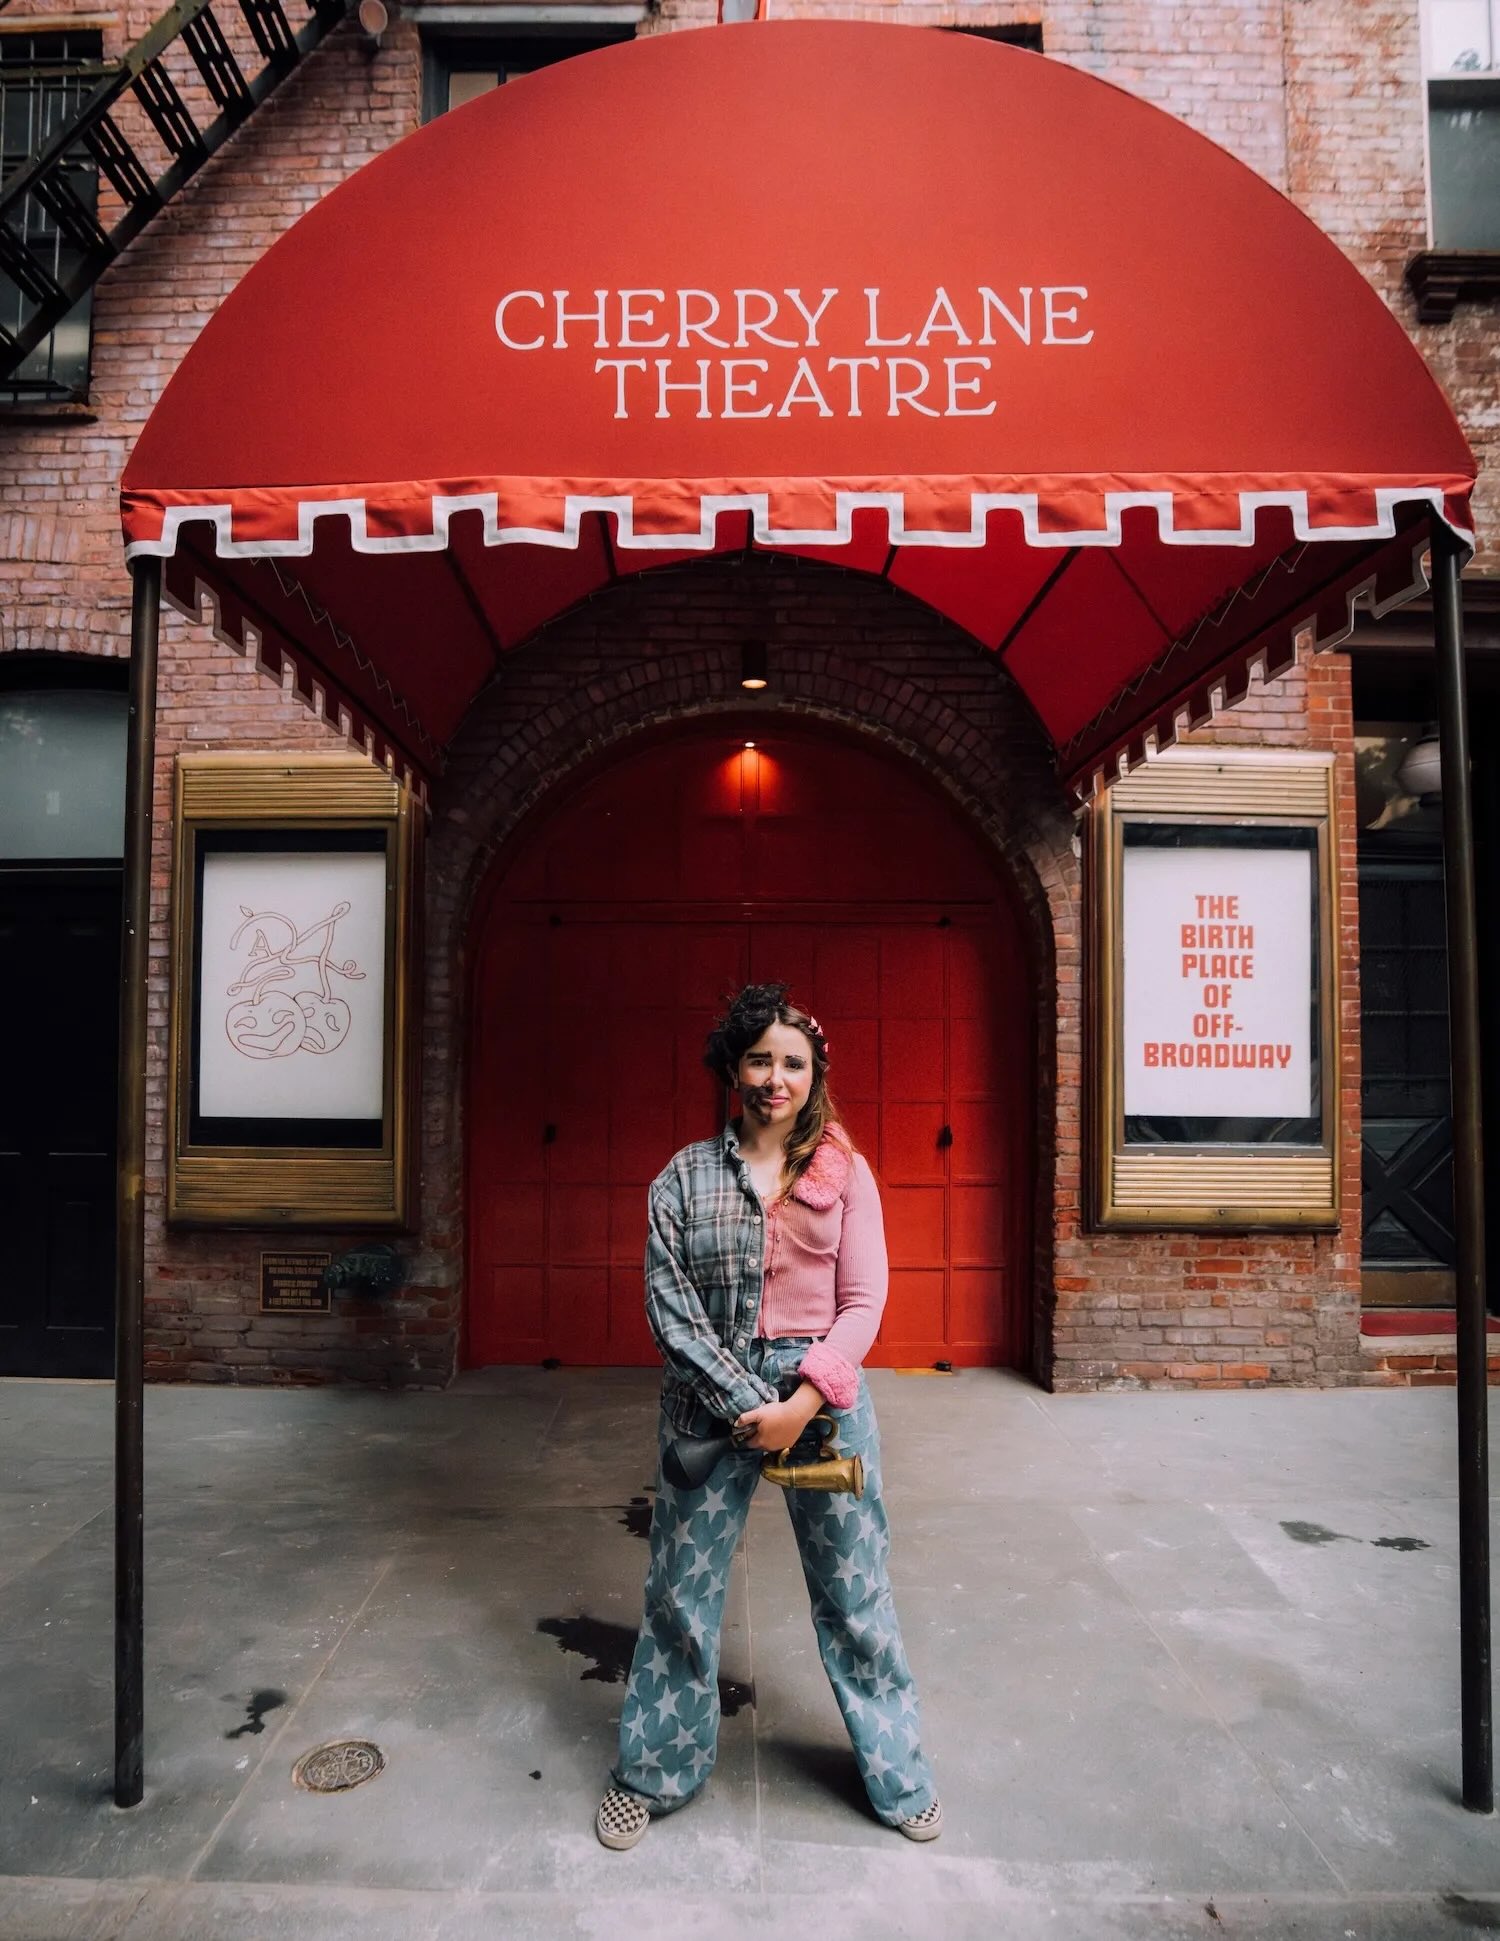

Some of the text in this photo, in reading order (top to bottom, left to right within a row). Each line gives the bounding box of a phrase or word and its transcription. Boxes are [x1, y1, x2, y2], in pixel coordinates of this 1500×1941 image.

[495, 286, 1095, 350] CHERRY LANE
[595, 356, 997, 419] THEATRE
[1195, 895, 1239, 919] THE
[1181, 924, 1254, 949] BIRTH
[1182, 954, 1254, 979] PLACE
[1203, 984, 1232, 1009] OF
[1193, 1013, 1244, 1039] OFF-
[1143, 1042, 1292, 1069] BROADWAY
